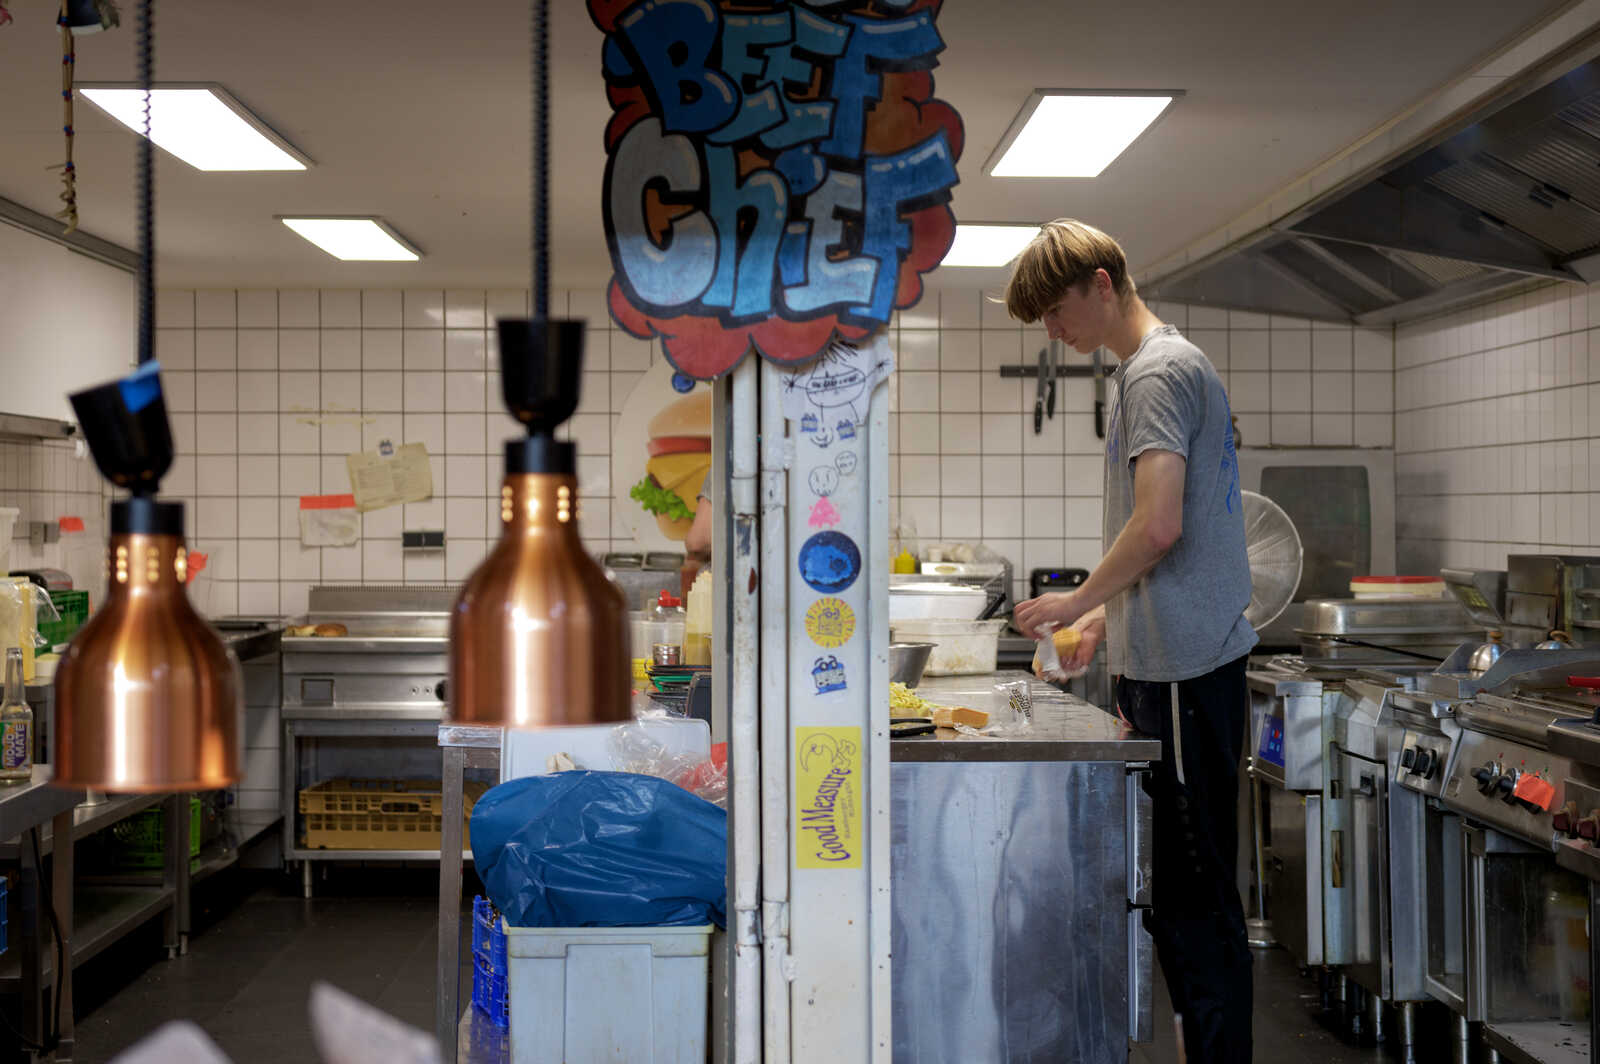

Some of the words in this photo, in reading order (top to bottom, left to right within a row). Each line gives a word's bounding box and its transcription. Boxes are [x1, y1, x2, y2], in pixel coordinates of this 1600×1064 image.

[616, 0, 947, 160] BEEF
[7, 734, 15, 767] MOJO
[15, 721, 25, 758] MATE
[800, 767, 852, 823] Measure
[801, 824, 852, 862] Good
